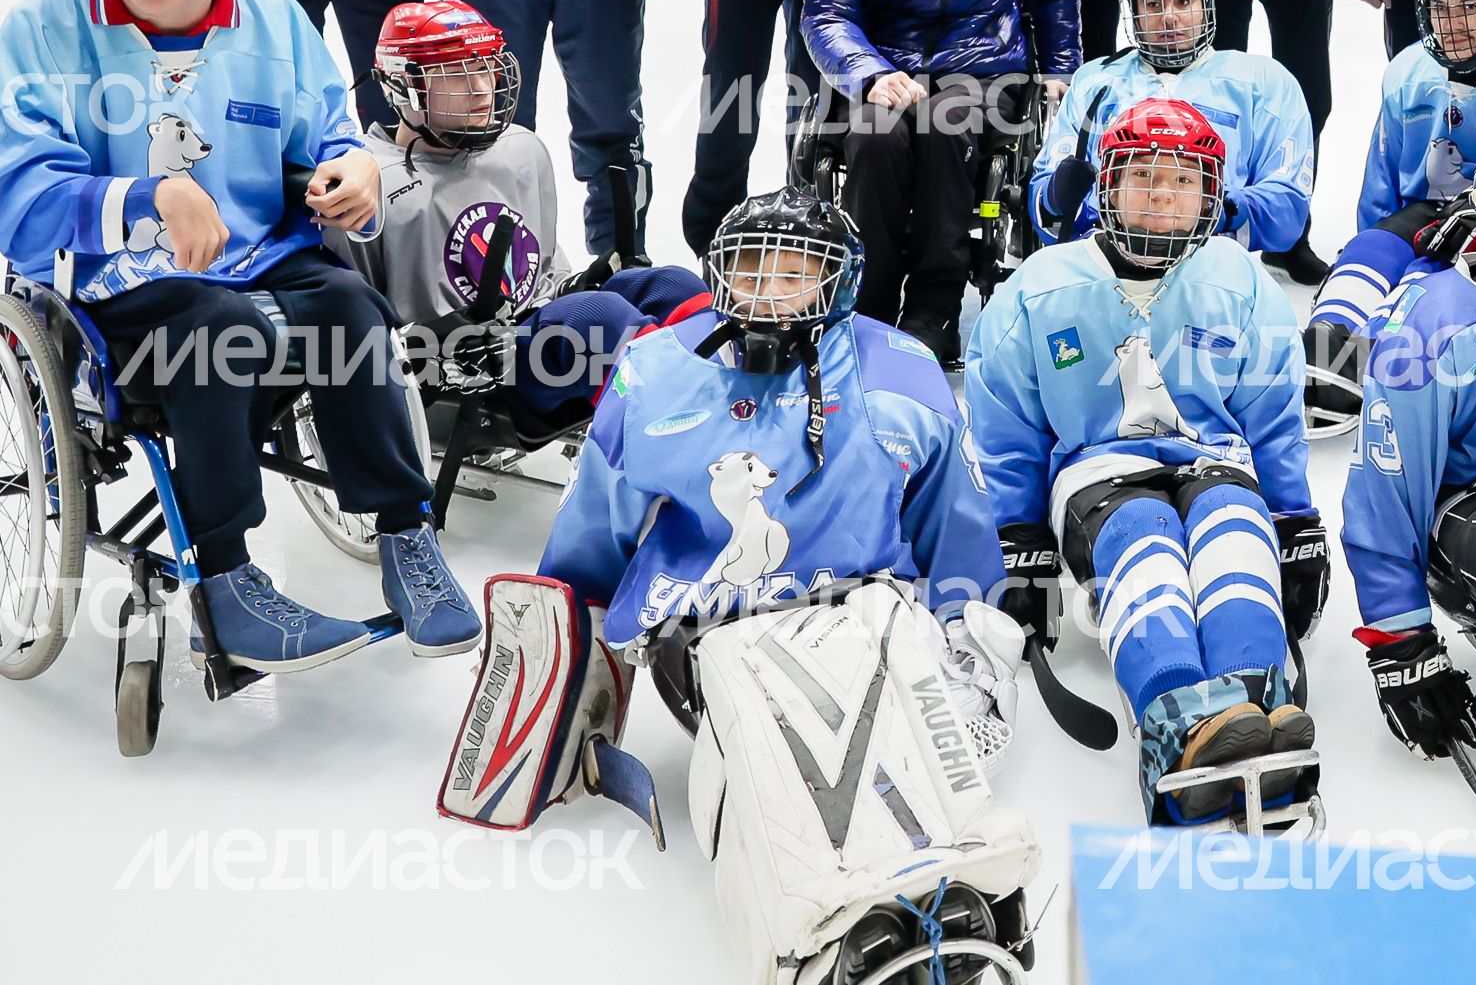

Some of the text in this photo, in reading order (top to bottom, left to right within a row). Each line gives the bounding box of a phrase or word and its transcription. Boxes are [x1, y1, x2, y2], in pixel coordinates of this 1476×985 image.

[1150, 127, 1188, 137] CCM
[1002, 549, 1062, 570] AUER
[1282, 542, 1326, 563] UER
[810, 614, 849, 650] VISION
[453, 644, 515, 791] VAUGHN
[911, 673, 982, 795] VAUGHN
